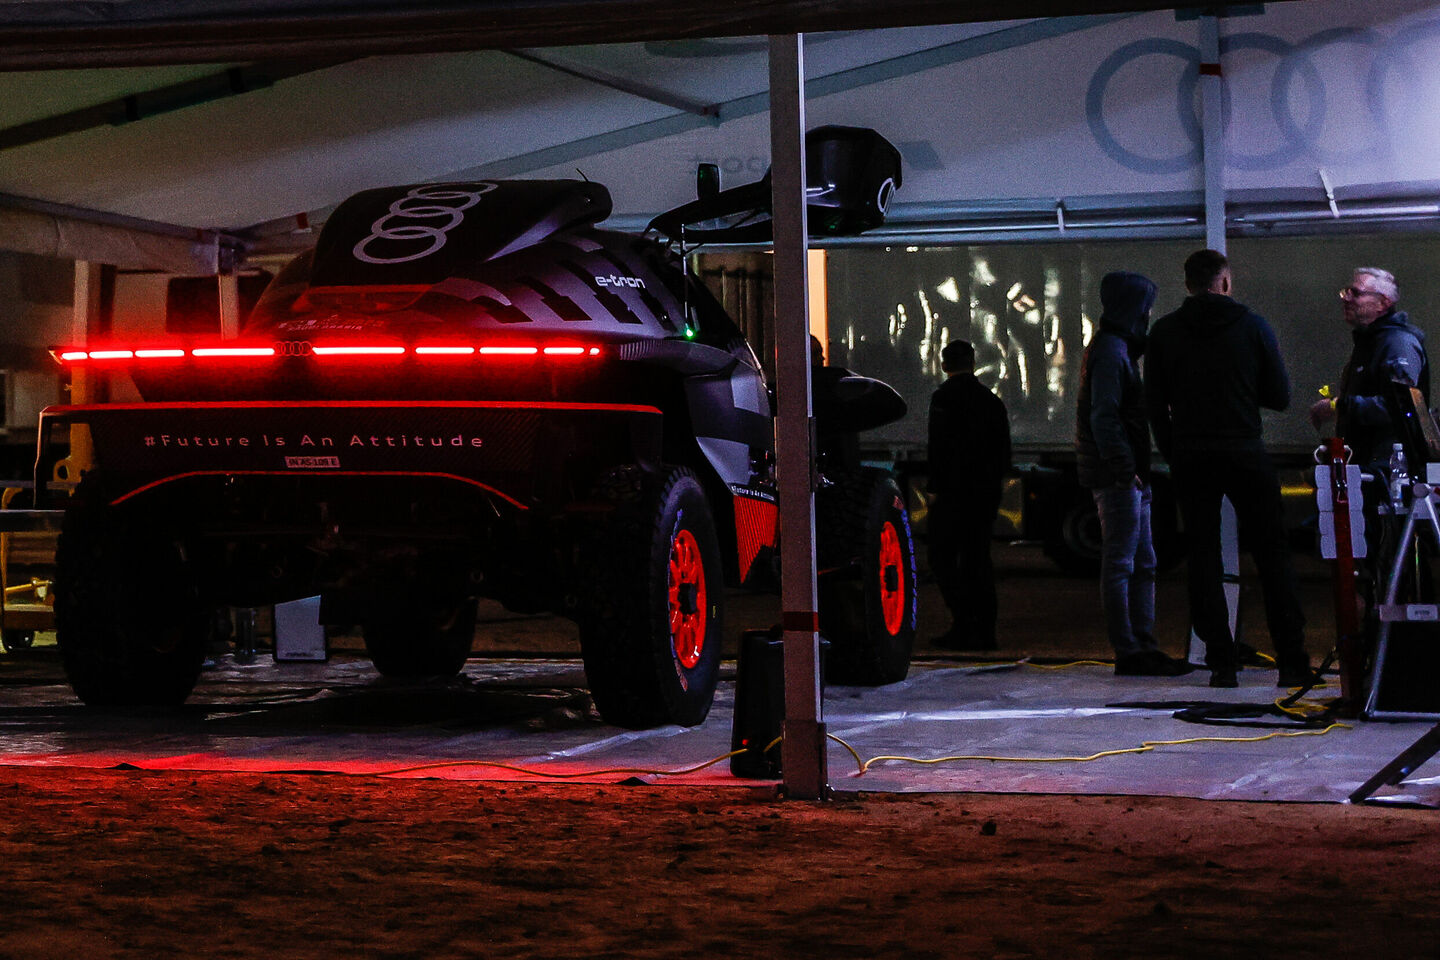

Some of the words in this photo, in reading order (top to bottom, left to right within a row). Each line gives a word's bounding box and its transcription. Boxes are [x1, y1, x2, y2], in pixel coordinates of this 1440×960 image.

[594, 274, 646, 289] e-tron
[144, 434, 250, 448] #Future
[263, 434, 286, 448] Is
[300, 434, 334, 448] An
[350, 433, 484, 448] Attitude
